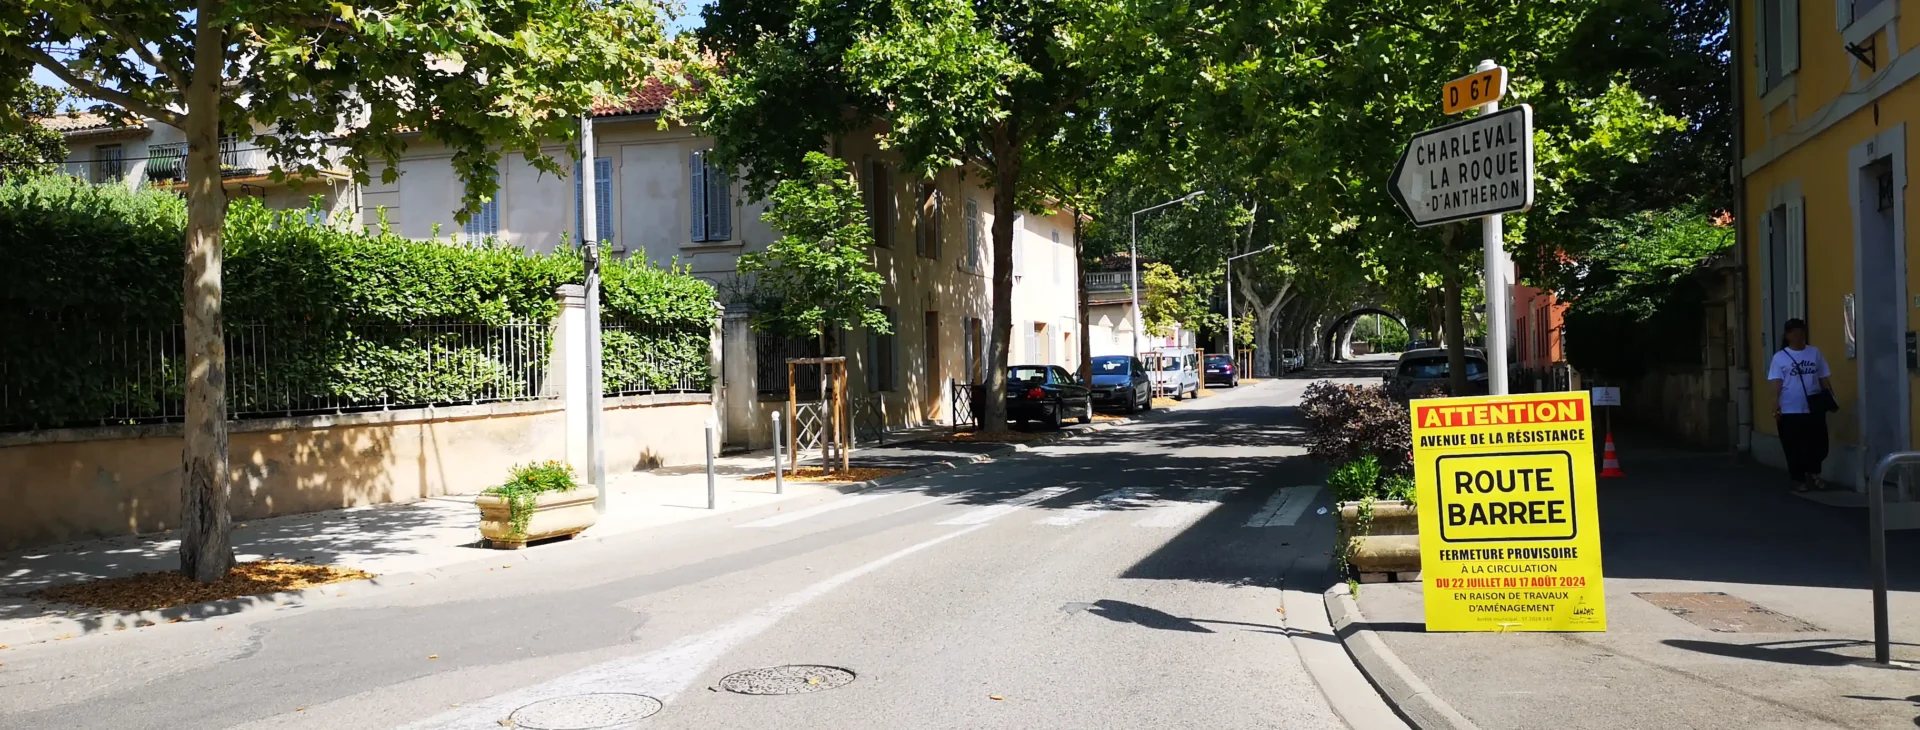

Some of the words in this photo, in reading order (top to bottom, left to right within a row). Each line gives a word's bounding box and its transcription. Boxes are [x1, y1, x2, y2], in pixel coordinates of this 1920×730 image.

[1450, 86, 1459, 107] D
[1471, 75, 1492, 100] 67
[1417, 122, 1517, 165] CHARLEVAL
[1430, 167, 1449, 190] LA
[1459, 151, 1518, 184] ROQUE
[1424, 402, 1577, 427] ATTENTION
[1420, 433, 1467, 447] AVENUE
[1470, 433, 1485, 444] DE
[1489, 432, 1504, 444] LA
[1507, 428, 1585, 443] RÉSISTANCE
[1455, 468, 1554, 494] ROUTE
[1448, 500, 1566, 526] BARREE
[1440, 549, 1504, 561] FERMETURE
[1507, 547, 1578, 559] PROVISOIRE
[1461, 563, 1468, 573] À
[1472, 565, 1484, 573] LA
[1487, 564, 1557, 573] CIRCULATION
[1436, 578, 1449, 588] DU
[1452, 578, 1464, 588] 22
[1467, 578, 1501, 588] JUILLET
[1504, 578, 1516, 587] AU
[1519, 577, 1529, 587] 17
[1531, 576, 1556, 587] AOÛT
[1560, 576, 1586, 587] 2024
[1469, 592, 1505, 600] RAISON
[1509, 592, 1520, 600] DE
